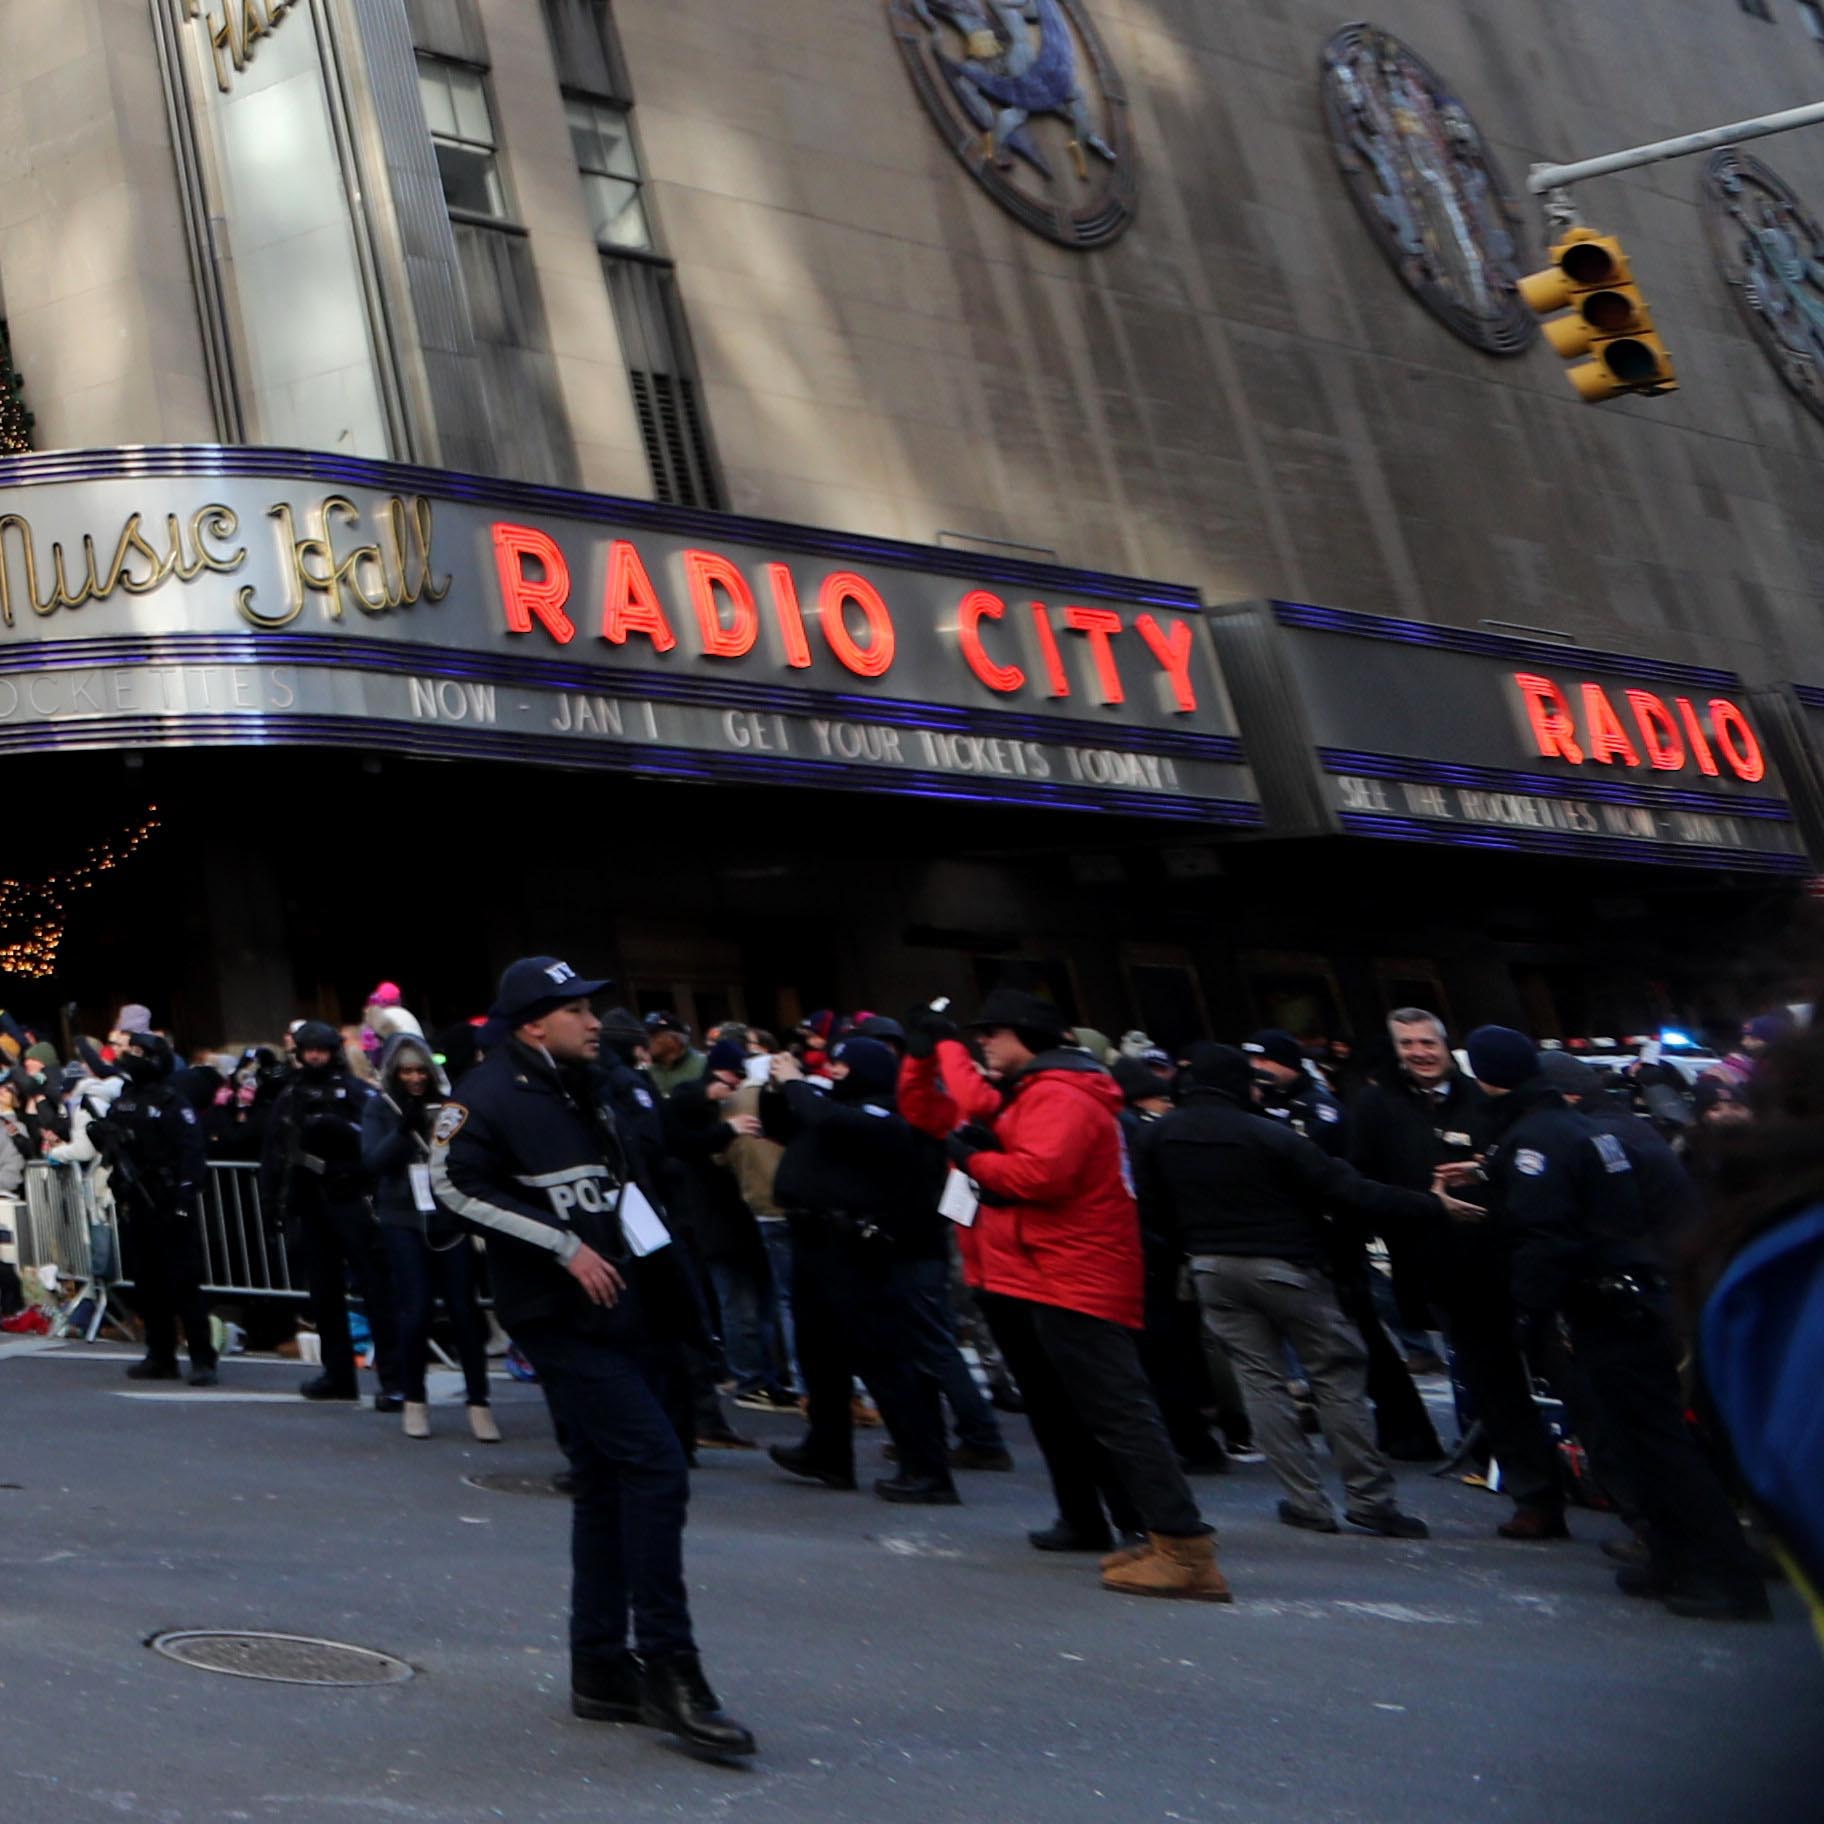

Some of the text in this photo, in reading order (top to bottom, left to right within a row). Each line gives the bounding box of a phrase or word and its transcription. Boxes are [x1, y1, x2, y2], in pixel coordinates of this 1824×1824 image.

[236, 494, 451, 628] Hall
[491, 521, 1198, 713] RADIO CITY
[409, 677, 496, 723] NOW
[552, 693, 623, 735] JAN
[722, 710, 1179, 789] GET YOUR TICKETS TODAY!
[1514, 672, 1766, 783] RADIO
